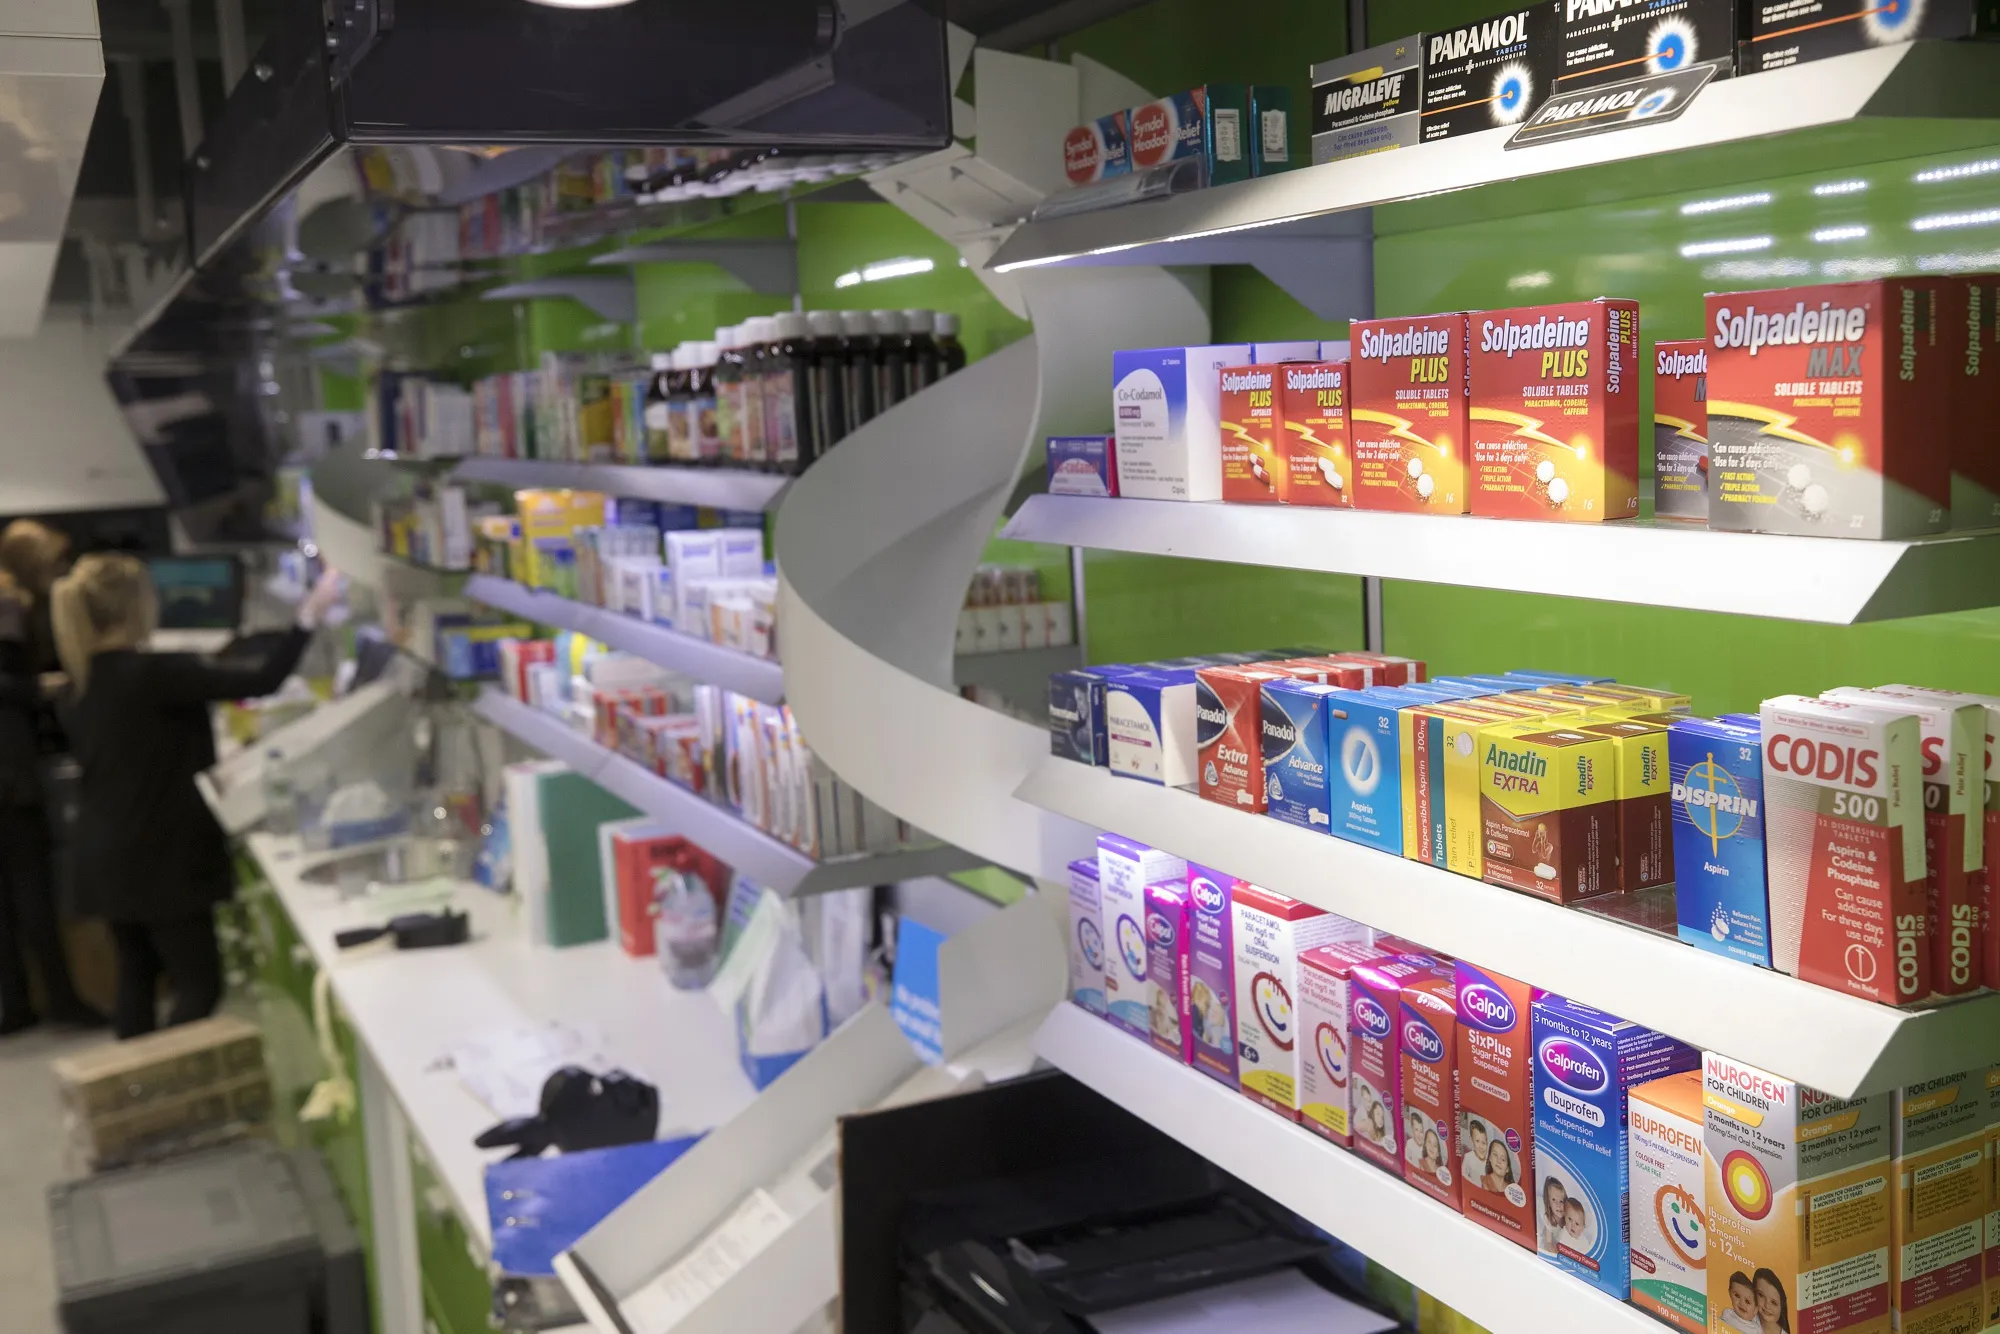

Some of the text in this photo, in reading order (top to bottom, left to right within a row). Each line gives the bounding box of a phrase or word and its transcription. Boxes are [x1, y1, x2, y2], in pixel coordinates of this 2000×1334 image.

[1429, 12, 1527, 65] PARAMOL
[1496, 43, 1527, 56] TABLETS
[1323, 75, 1401, 115] MIGRALEVE
[1535, 88, 1643, 124] PARAMOL
[1133, 113, 1165, 137] Syndol
[1481, 315, 1589, 357] Solpadeine
[1620, 309, 1631, 344] PLUS
[1713, 302, 1867, 355] Solpadeine
[1899, 288, 1916, 381] Solpadeine
[1360, 326, 1449, 363] Solpadeine
[1607, 309, 1622, 394] Solpadeine
[1411, 357, 1449, 383] PLUS
[1541, 349, 1589, 379] PLUS
[1806, 345, 1865, 379] MAX
[1222, 371, 1272, 394] Solpadeine
[1287, 369, 1342, 393] Solpadeine
[1522, 384, 1588, 397] SOLUBLE TABLETS
[1774, 381, 1862, 396] SOLUBLE TABLETS
[1250, 390, 1272, 407] PLUS
[1317, 390, 1342, 407] PLUS
[1396, 388, 1449, 400] SOLUBLE TABLETS
[1583, 499, 1593, 510] 16
[1626, 497, 1637, 508] 16
[1197, 705, 1225, 725] Panadol
[1378, 716, 1389, 729] 32
[1263, 720, 1294, 742] Panadol
[1217, 744, 1248, 765] Extra
[1288, 756, 1323, 774] Advance
[1486, 743, 1547, 777] Anadin
[1642, 746, 1650, 786] Anadin
[1739, 747, 1752, 761] 32
[1767, 734, 1879, 788] CODIS
[1419, 760, 1428, 797] Aspirin
[1493, 772, 1540, 794] EXTRA
[1576, 755, 1586, 796] Anadin
[1351, 801, 1374, 815] Aspirin
[1672, 783, 1757, 818] DISPRIN
[1833, 791, 1879, 821] 500
[1420, 799, 1429, 858] Dispersible
[1435, 823, 1444, 862] Tablets
[1828, 841, 1877, 862] Aspirin &
[1704, 862, 1730, 876] Aspirin
[1827, 867, 1880, 889] Phosphate
[1832, 856, 1874, 875] Codeine
[1195, 884, 1221, 908] Calpol
[1536, 880, 1543, 890] 32
[1835, 887, 1883, 909] Can cause
[1822, 909, 1884, 938] For three days
[1837, 902, 1884, 920] addiction.
[1916, 915, 1925, 936] 500
[1846, 929, 1885, 948] use only.
[1951, 904, 1971, 985] CODIS
[1896, 914, 1919, 995] CODIS
[1357, 1003, 1386, 1029] Calpol
[1467, 991, 1509, 1022] Calpol
[1408, 1027, 1438, 1053] Calpol
[1468, 1029, 1512, 1058] SixPlus
[1534, 1012, 1540, 1023] 3
[1541, 1016, 1569, 1034] months
[1571, 1027, 1579, 1038] to
[1581, 1030, 1589, 1042] 12
[1591, 1035, 1613, 1050] years
[1471, 1045, 1509, 1068] Sugar Free
[1473, 1056, 1508, 1077] Suspension
[1546, 1048, 1600, 1082] Calprofen
[1411, 1058, 1440, 1082] SixPlus
[1707, 1057, 1785, 1105] NUROFEN
[1473, 1078, 1508, 1100] Paracetamol
[1707, 1077, 1770, 1112] FOR CHILDREN
[1550, 1090, 1598, 1122] Ibuprofen
[1708, 1096, 1736, 1115] Orange
[1801, 1107, 1821, 1122] FOR
[1555, 1113, 1594, 1138] Suspension
[1631, 1111, 1702, 1156] IBUPROFEN
[1708, 1110, 1786, 1150] 3 months to 12 years
[1801, 1123, 1833, 1138] Orange
[1561, 1129, 1576, 1143] Fever
[1582, 1138, 1595, 1151] Pain
[1595, 1144, 1612, 1157] Relief
[1738, 1135, 1750, 1147] Oral
[1751, 1141, 1782, 1160] Suspension
[1801, 1124, 1881, 1153] 3 months to 12 years
[1470, 1200, 1500, 1221] Strawberry
[1708, 1205, 1752, 1236] Ibuprofen
[1709, 1218, 1745, 1248] 3 months
[1709, 1238, 1755, 1269] to 12 years
[1657, 1305, 1669, 1318] 100
